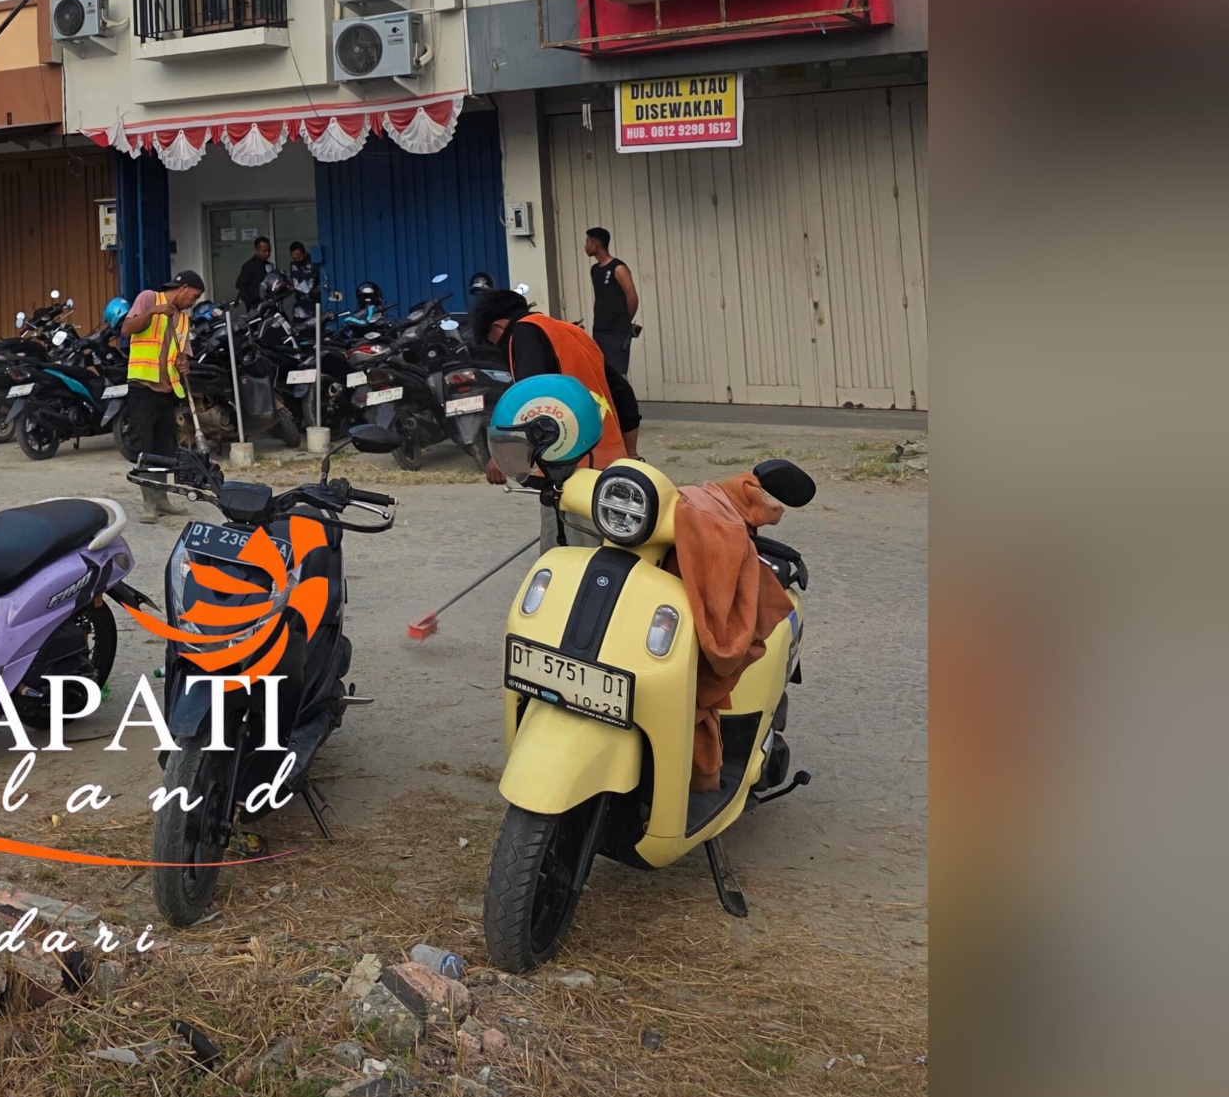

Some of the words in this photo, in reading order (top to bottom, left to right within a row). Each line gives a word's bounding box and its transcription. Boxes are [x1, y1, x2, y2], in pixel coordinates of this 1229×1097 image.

[631, 80, 683, 100] DIJUAL
[689, 77, 728, 96] ATAU
[635, 99, 723, 121] DISEWAKAN
[626, 127, 648, 140] HUB.
[678, 123, 705, 136] 9298
[708, 121, 731, 134] 1612
[192, 524, 213, 538] DT
[46, 570, 93, 609] FINO
[513, 645, 533, 667] DT
[544, 655, 585, 686] 5751
[603, 674, 624, 697] DI
[514, 681, 539, 695] YAMAHA
